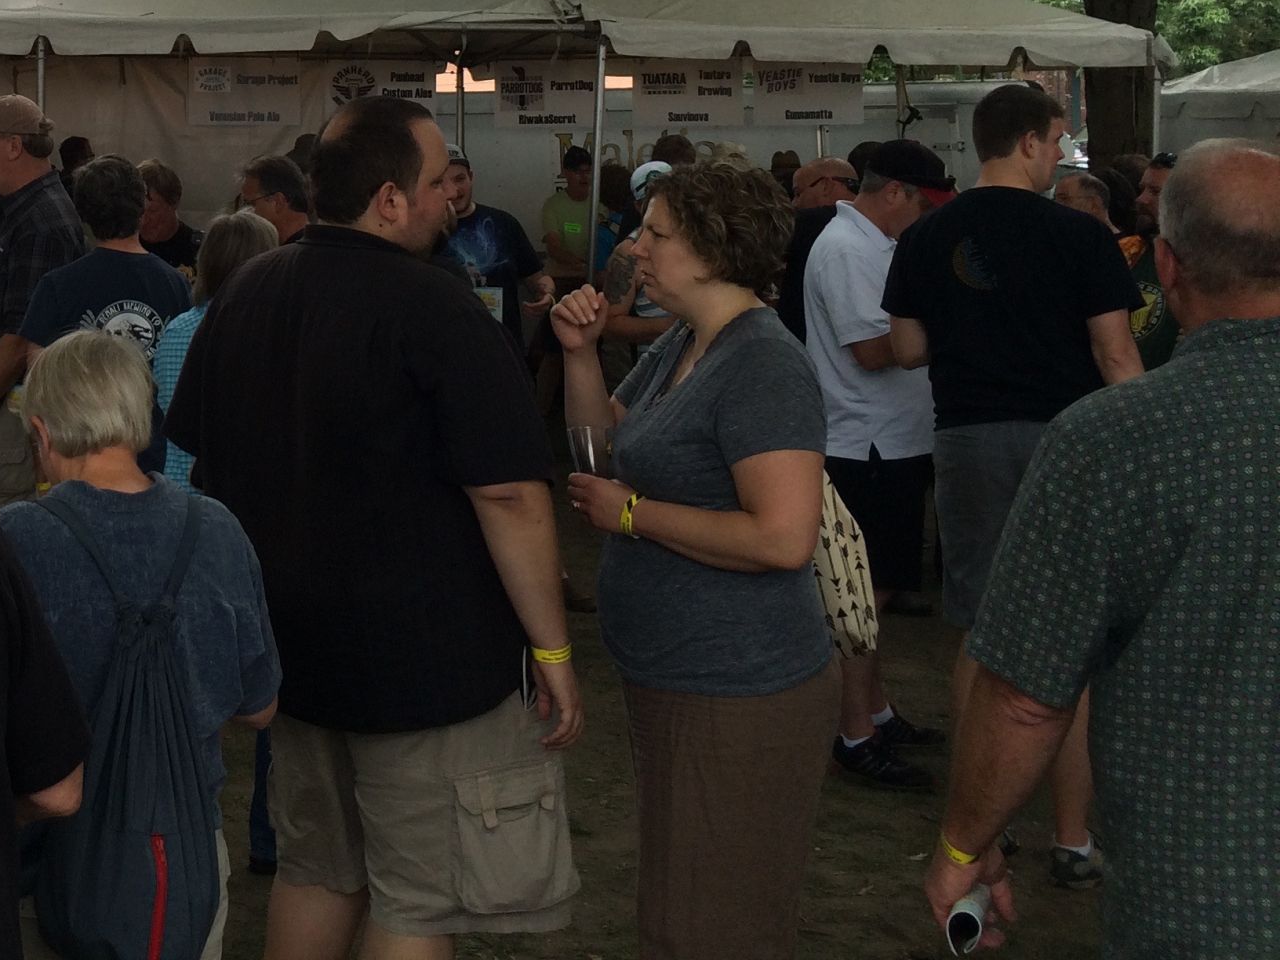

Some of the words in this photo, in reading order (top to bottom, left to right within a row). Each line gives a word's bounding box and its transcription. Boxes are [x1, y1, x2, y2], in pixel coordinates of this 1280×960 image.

[391, 72, 425, 82] Panhead
[641, 72, 687, 84] TUATARA
[758, 68, 803, 86] YEASTIE
[550, 80, 594, 92] ParrotDog
[697, 85, 732, 97] Brewing
[767, 79, 798, 93] BOYS
[382, 88, 413, 98] Custom
[668, 112, 709, 122] Sauvinova
